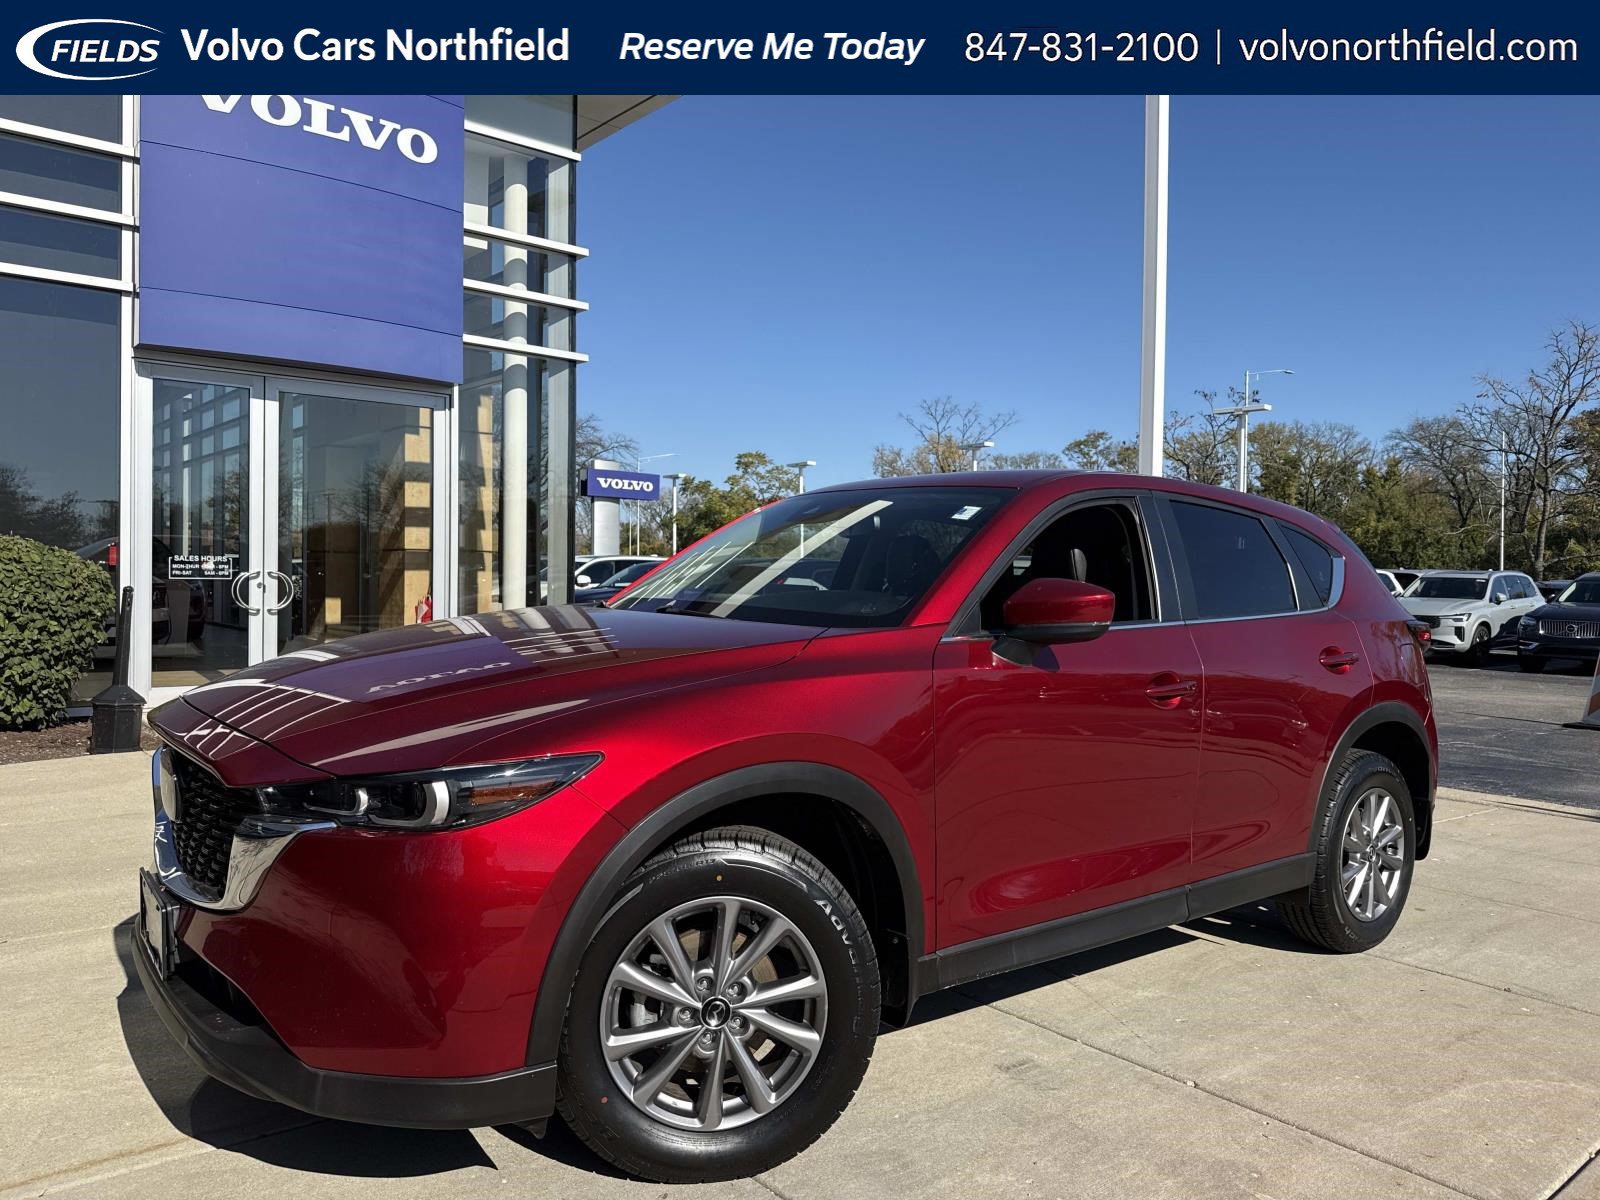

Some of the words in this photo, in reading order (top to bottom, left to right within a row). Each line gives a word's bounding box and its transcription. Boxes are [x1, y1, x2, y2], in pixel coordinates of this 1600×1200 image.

[201, 95, 438, 164] VOLVO
[596, 477, 654, 492] VOLVO
[173, 554, 200, 562] SALES
[200, 554, 228, 562] HOURS
